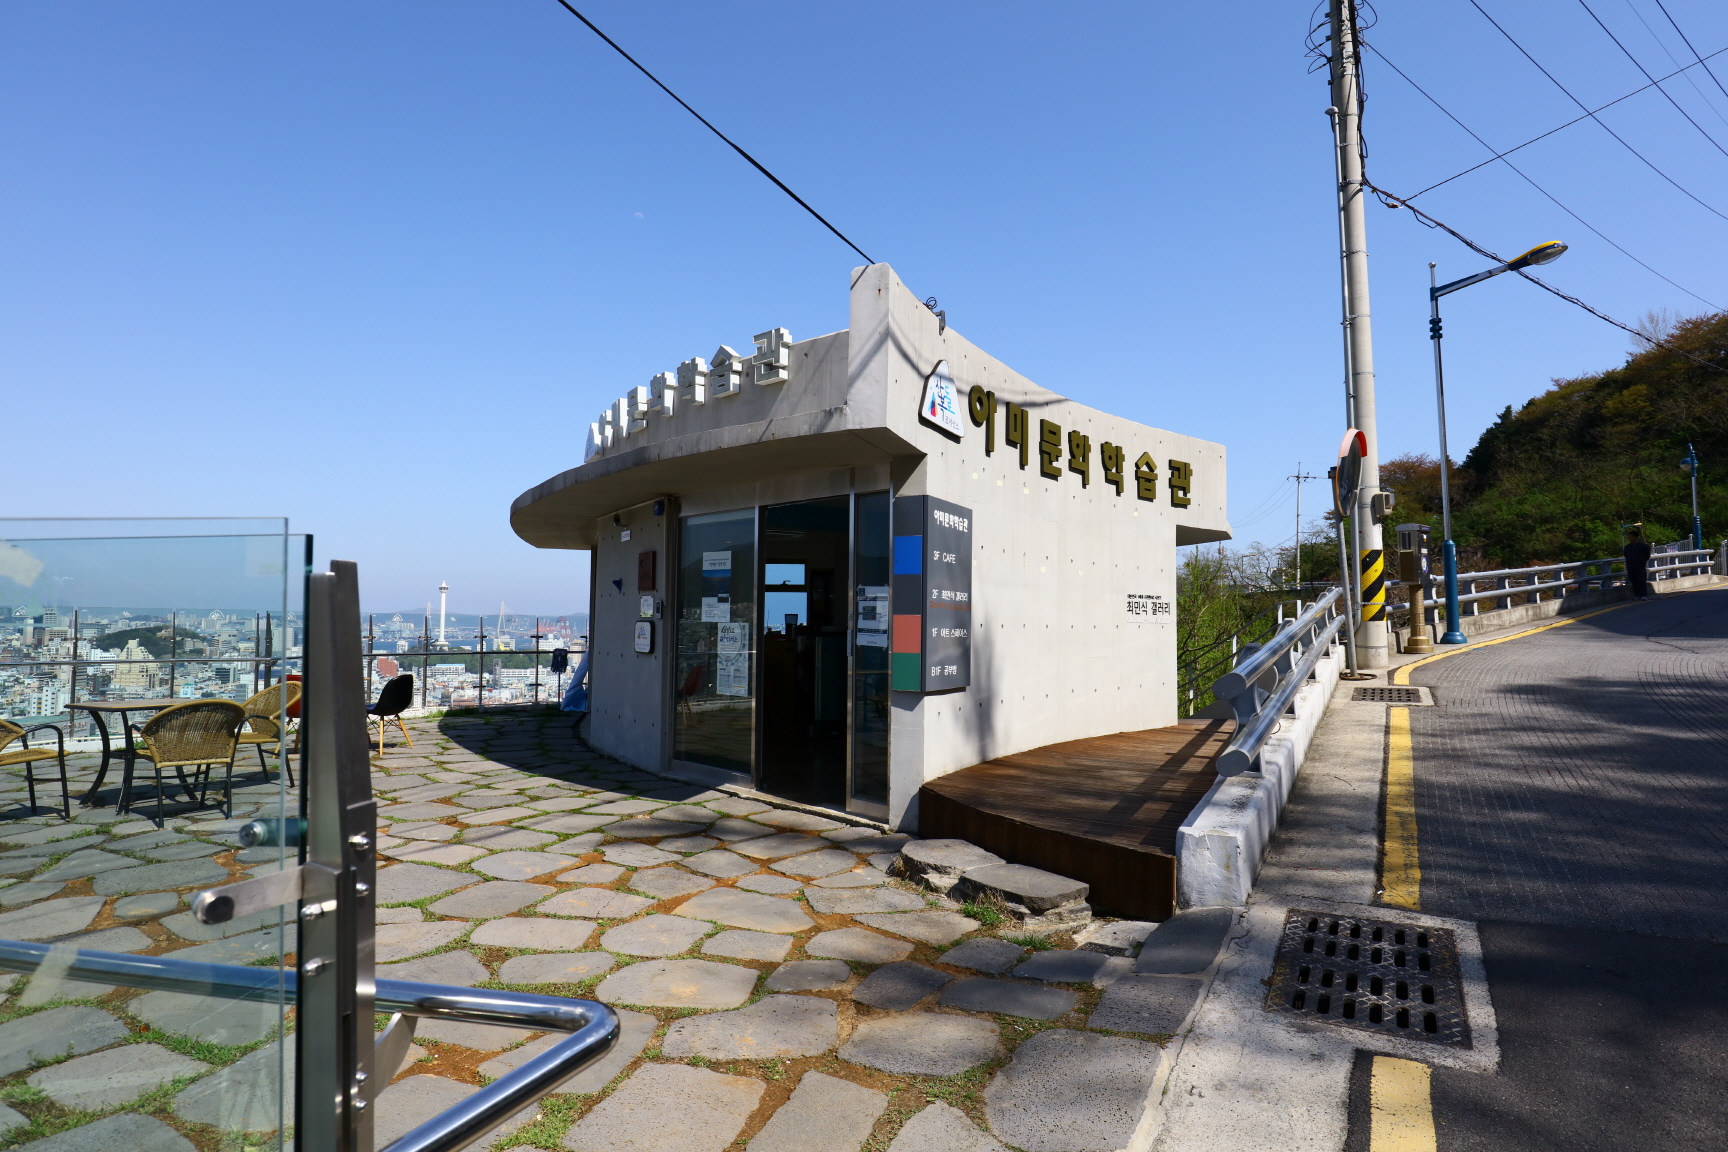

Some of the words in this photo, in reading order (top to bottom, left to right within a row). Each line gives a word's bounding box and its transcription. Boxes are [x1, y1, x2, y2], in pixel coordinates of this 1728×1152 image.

[968, 384, 1193, 509] 아미문화학습관
[933, 509, 969, 533] 아미문화학습관
[933, 550, 941, 561] 3F
[942, 552, 956, 564] CAFE
[931, 588, 939, 599] 2F
[1126, 600, 1148, 616] 최민식
[1150, 601, 1171, 616] 갤러리
[931, 627, 938, 638] 1F
[940, 627, 950, 638] 아트
[950, 628, 968, 638] 스페이스
[931, 665, 942, 677] B1F
[943, 664, 957, 676] 공부방
